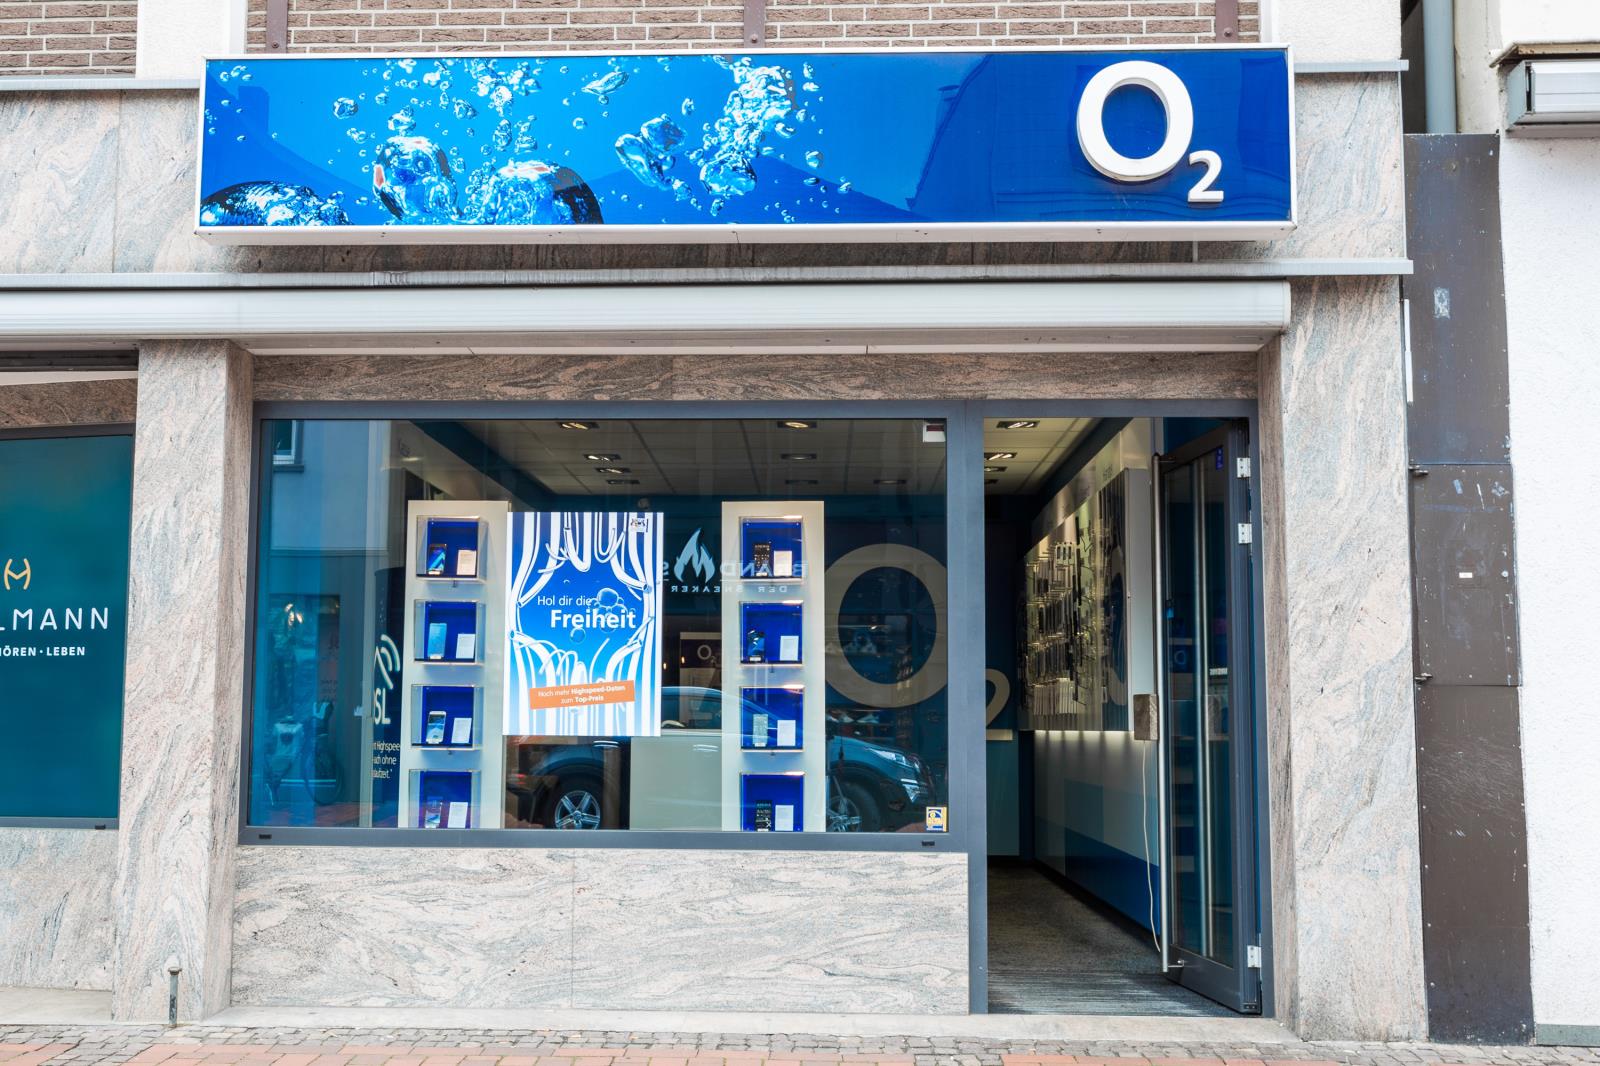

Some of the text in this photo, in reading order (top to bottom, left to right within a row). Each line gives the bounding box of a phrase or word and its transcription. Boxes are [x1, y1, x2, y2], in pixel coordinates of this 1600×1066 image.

[1077, 60, 1224, 202] O2
[538, 595, 592, 606] Hol dir die
[0, 607, 108, 631] MANN
[551, 608, 636, 629] Freiheit
[571, 685, 626, 696] Highspeed-Daten
[575, 695, 604, 704] Top-Preis
[373, 688, 391, 725] SL
[377, 741, 401, 753] Highspee
[382, 754, 397, 765] ohne
